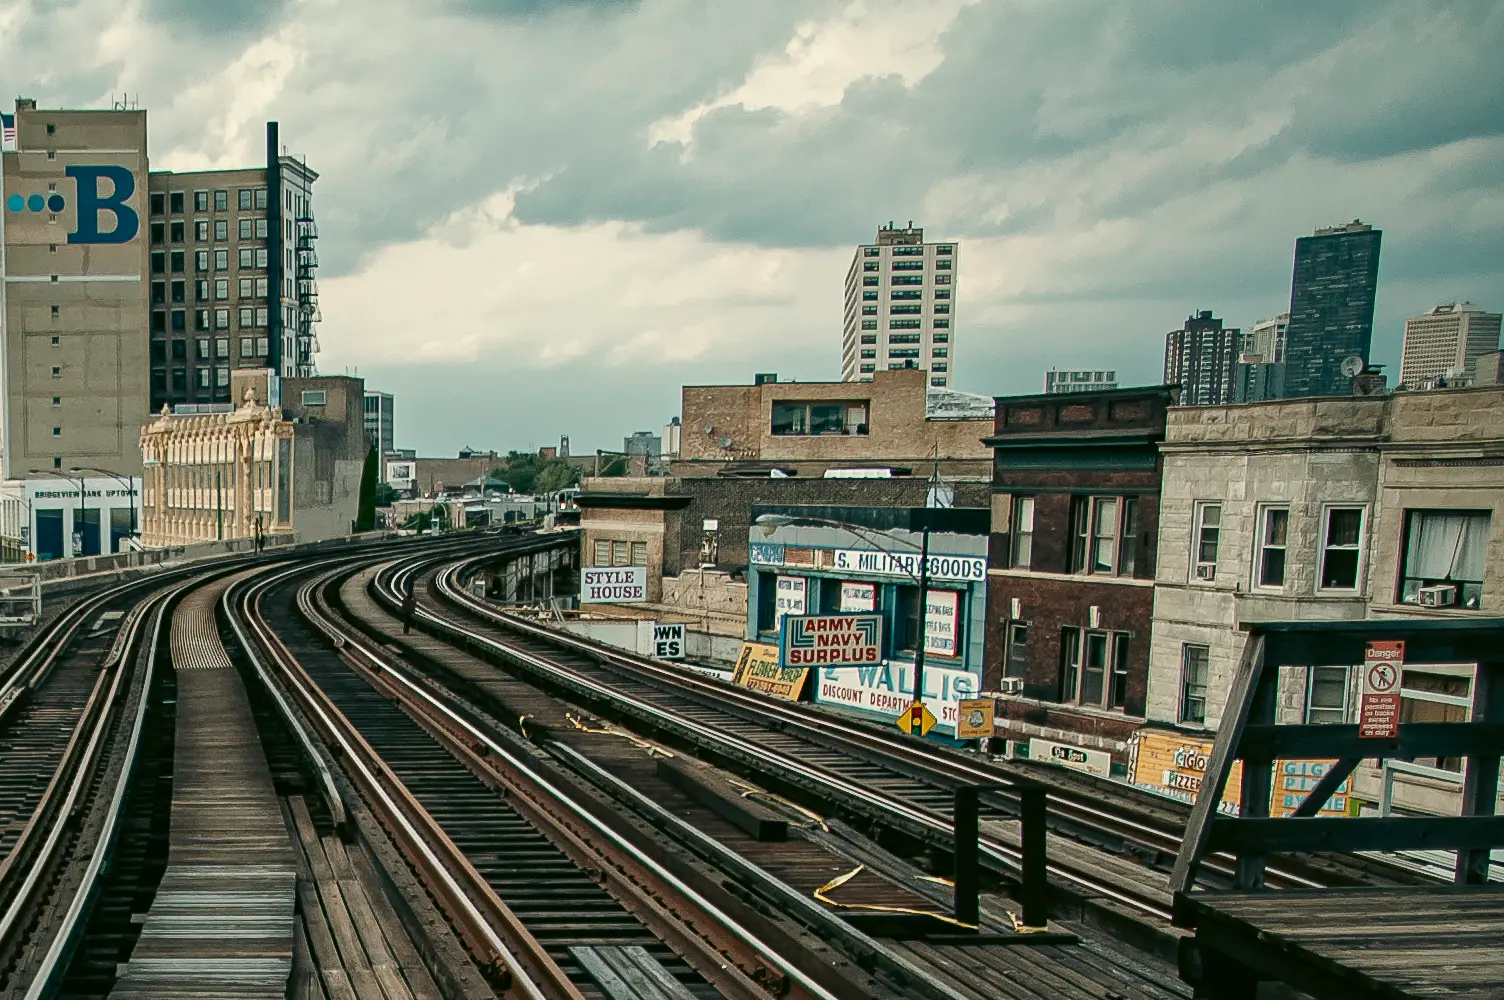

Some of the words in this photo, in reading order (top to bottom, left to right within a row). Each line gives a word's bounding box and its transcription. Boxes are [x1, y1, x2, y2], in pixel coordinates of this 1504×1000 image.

[65, 165, 139, 244] B
[34, 491, 80, 499] BRIDGEVIEW
[930, 557, 983, 578] GOODS
[584, 571, 634, 585] STYLE
[590, 586, 642, 599] HOUSE
[804, 618, 856, 632] ARMY
[817, 633, 863, 647] NAVY
[790, 648, 877, 664] SURPLUS
[1367, 648, 1401, 660] Danger
[857, 663, 973, 701] WALLIS
[823, 684, 863, 703] DISCOUNT
